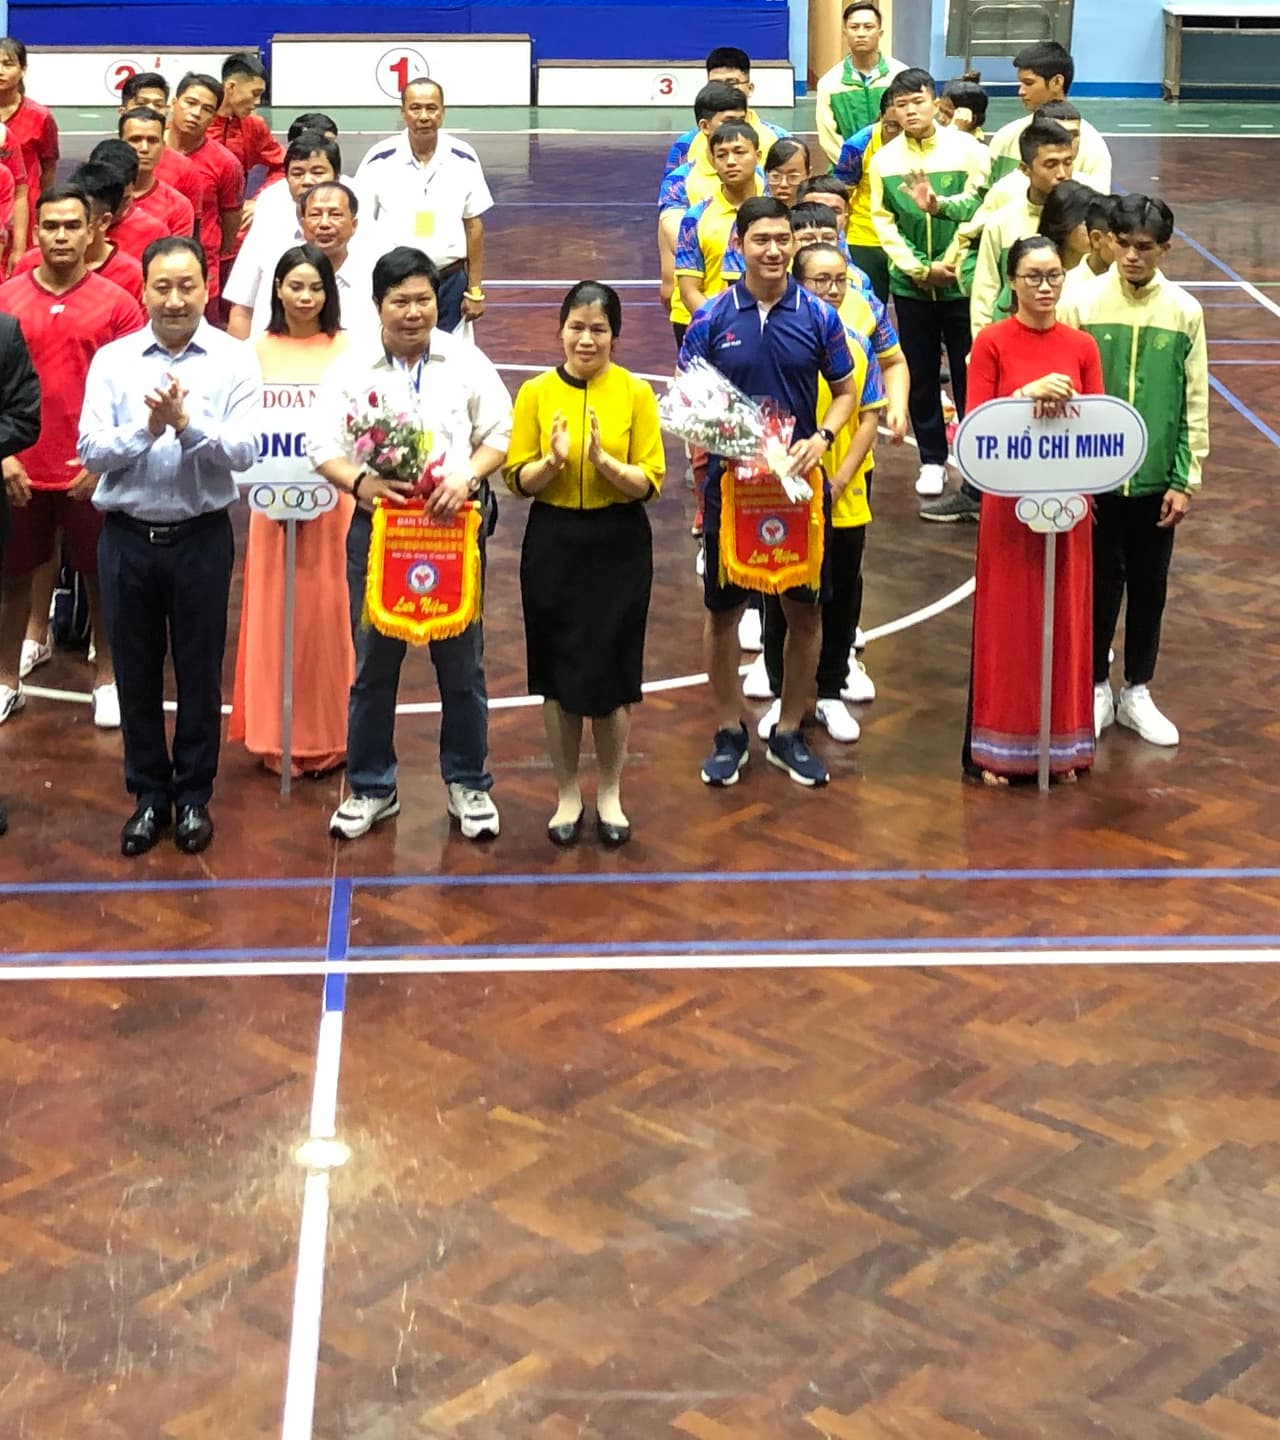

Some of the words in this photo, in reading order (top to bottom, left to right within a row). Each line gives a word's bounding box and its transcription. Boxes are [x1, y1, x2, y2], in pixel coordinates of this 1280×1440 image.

[390, 57, 409, 92] 1
[659, 78, 673, 95] 3
[976, 435, 999, 459] TP.
[1007, 425, 1032, 459] HỒ
[1039, 429, 1069, 459] CHÍ
[1076, 433, 1125, 458] MINH
